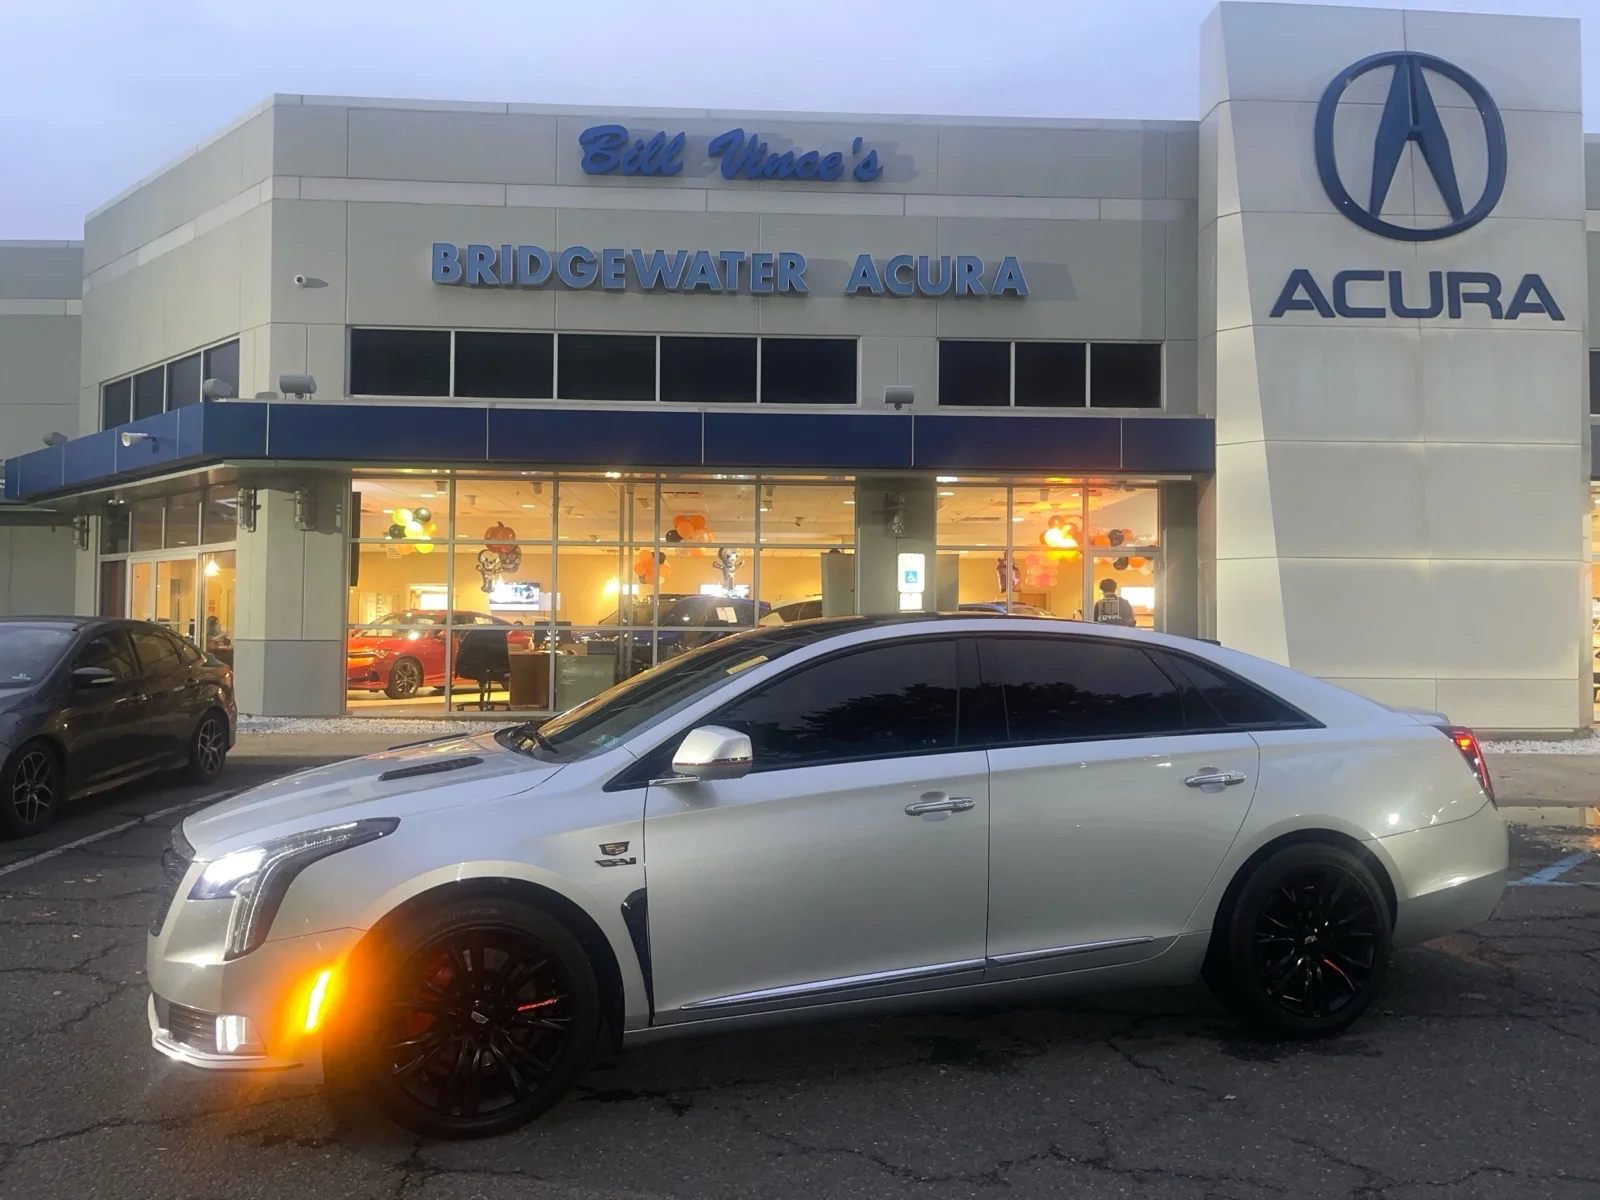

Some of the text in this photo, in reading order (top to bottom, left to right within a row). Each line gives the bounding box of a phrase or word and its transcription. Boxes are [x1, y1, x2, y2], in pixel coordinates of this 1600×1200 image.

[579, 124, 883, 182] Bill Vince's
[432, 242, 1031, 299] BRIDGEWATER ACURA
[1269, 269, 1566, 321] ACURA
